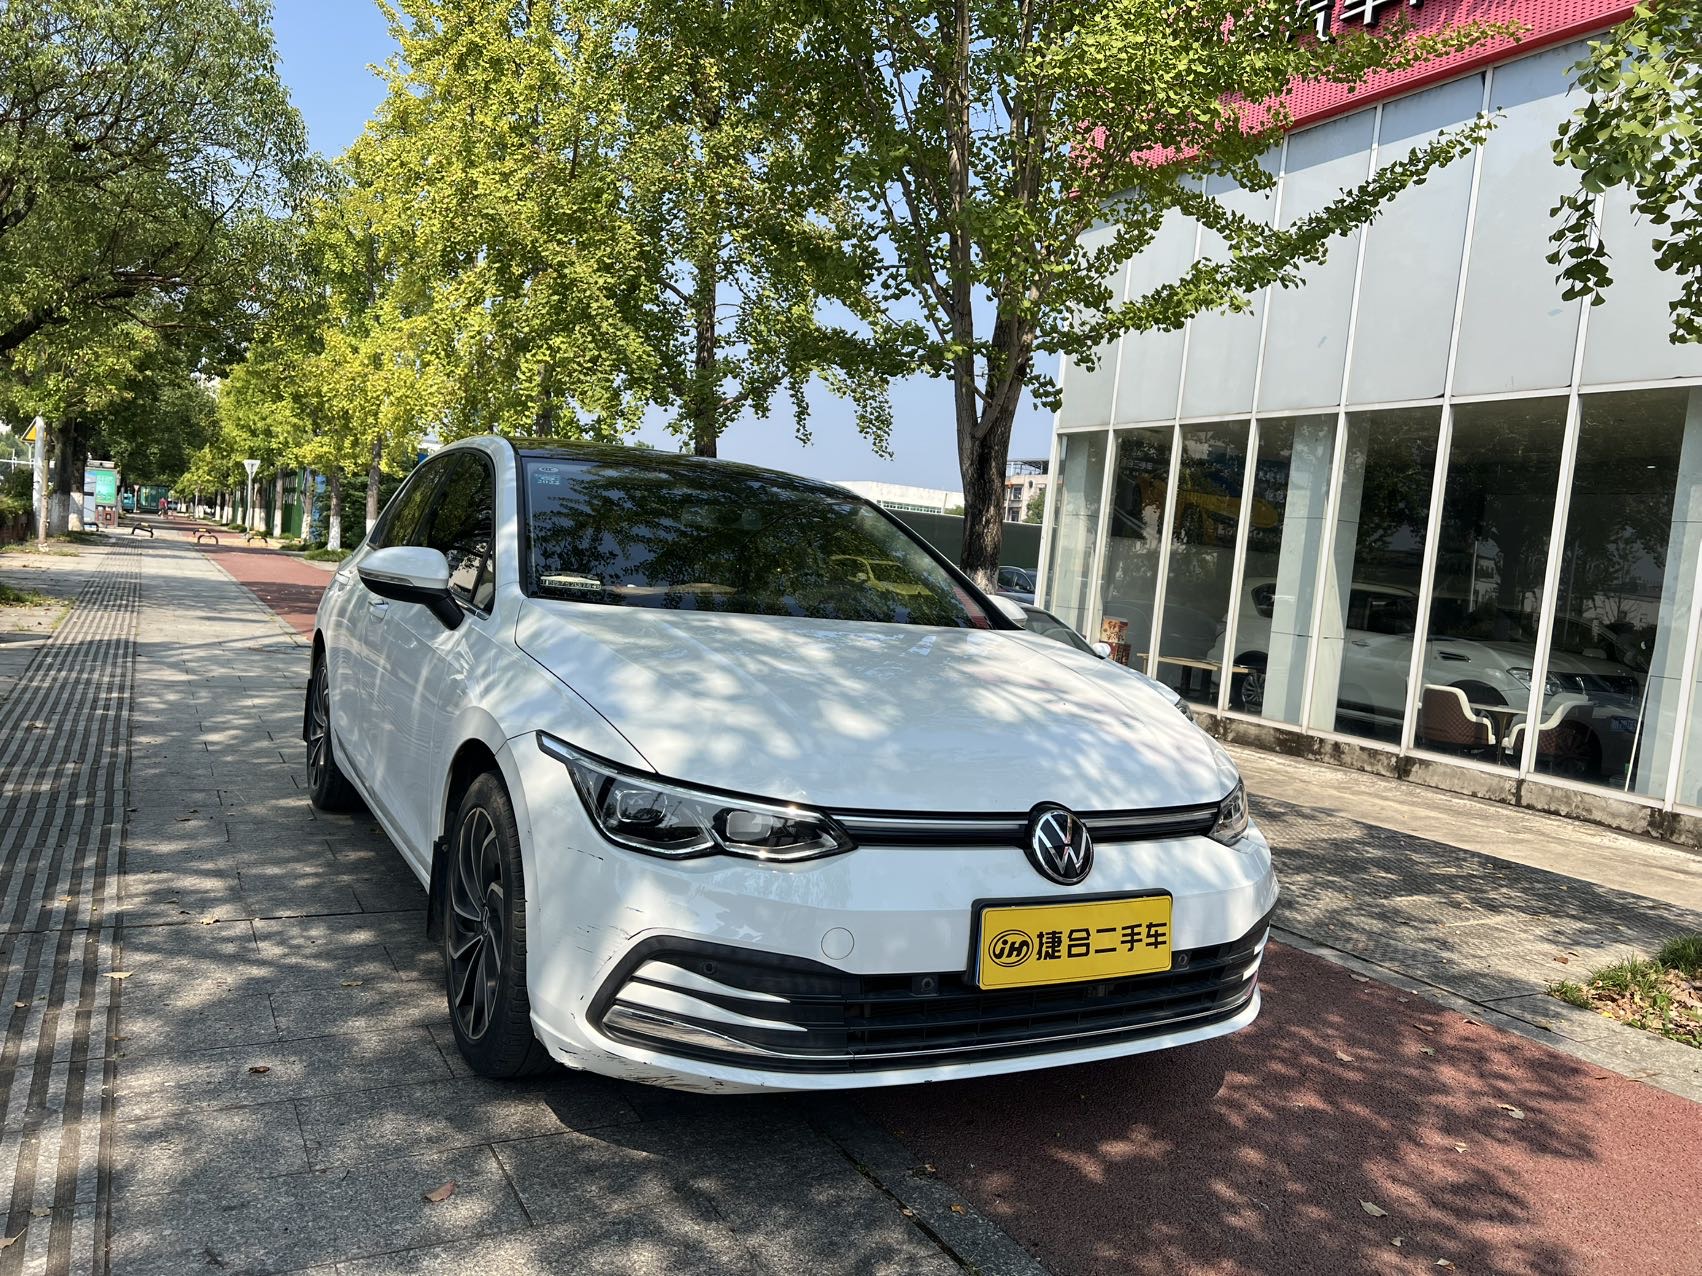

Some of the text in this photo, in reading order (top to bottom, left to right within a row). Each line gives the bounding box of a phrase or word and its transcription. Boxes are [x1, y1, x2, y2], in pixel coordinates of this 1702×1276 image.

[1036, 922, 1167, 961] 捷合二手车
